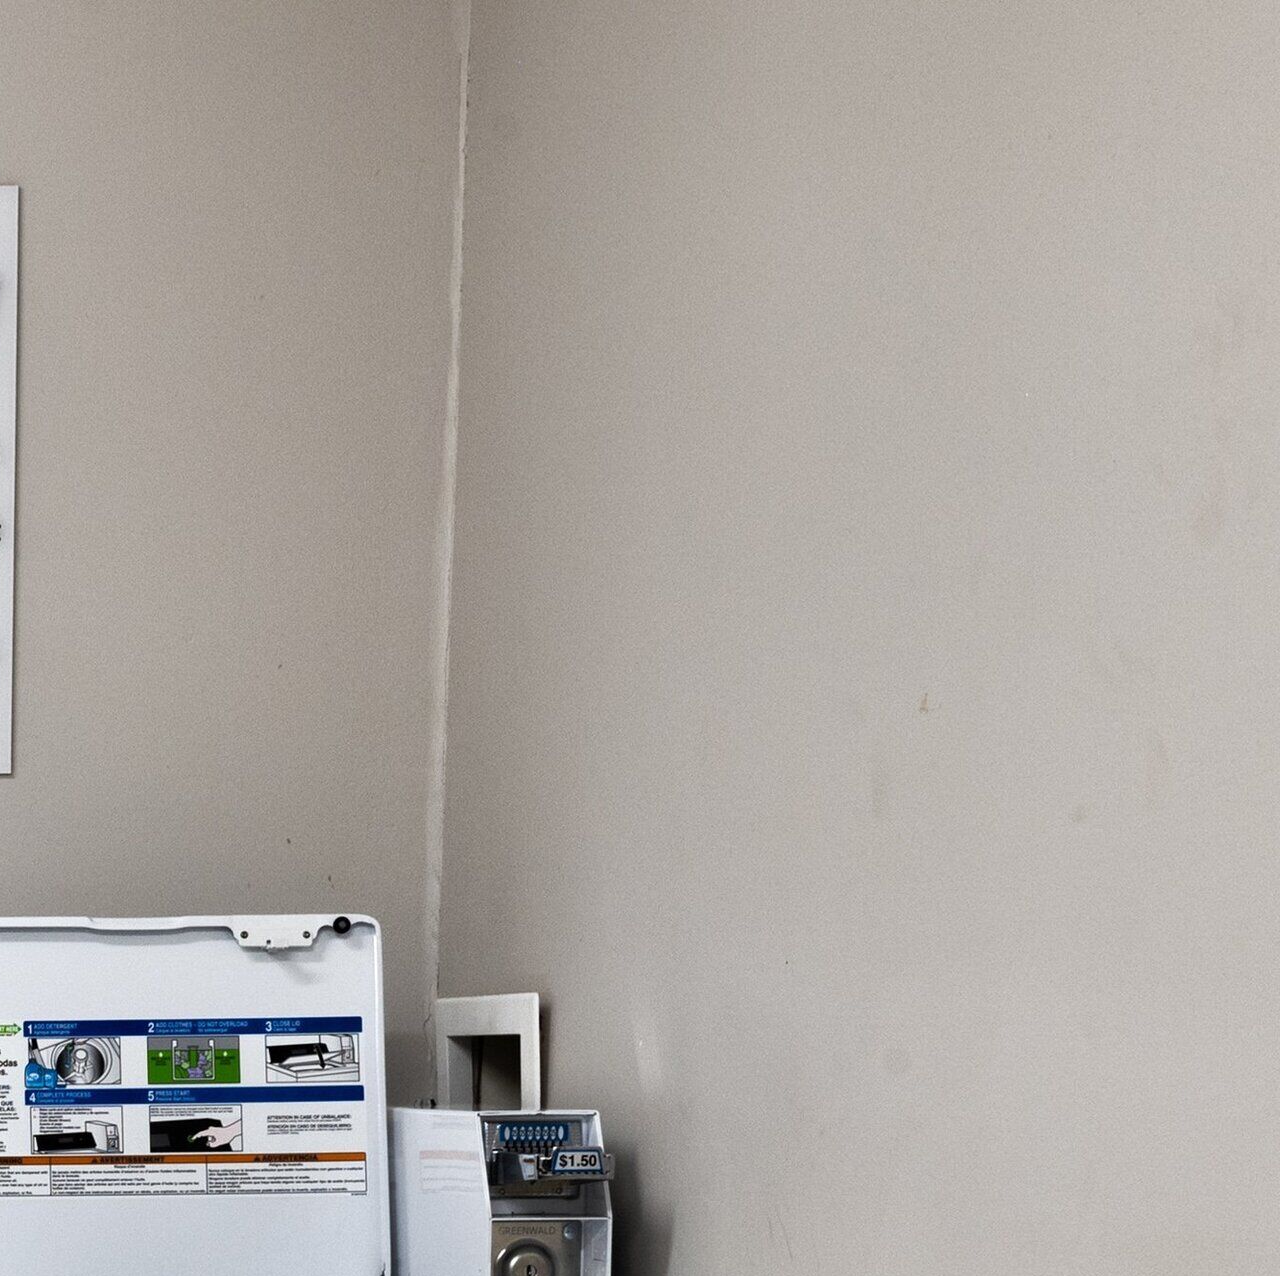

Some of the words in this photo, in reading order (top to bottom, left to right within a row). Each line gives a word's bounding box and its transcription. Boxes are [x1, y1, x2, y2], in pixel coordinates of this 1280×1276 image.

[27, 1024, 32, 1035] 1
[147, 1022, 155, 1033] 2
[265, 1020, 272, 1032] 3
[29, 1092, 37, 1103] 4
[147, 1090, 155, 1102] 5
[559, 1154, 597, 1168] $1.50
[498, 1225, 556, 1235] GREENWALD
